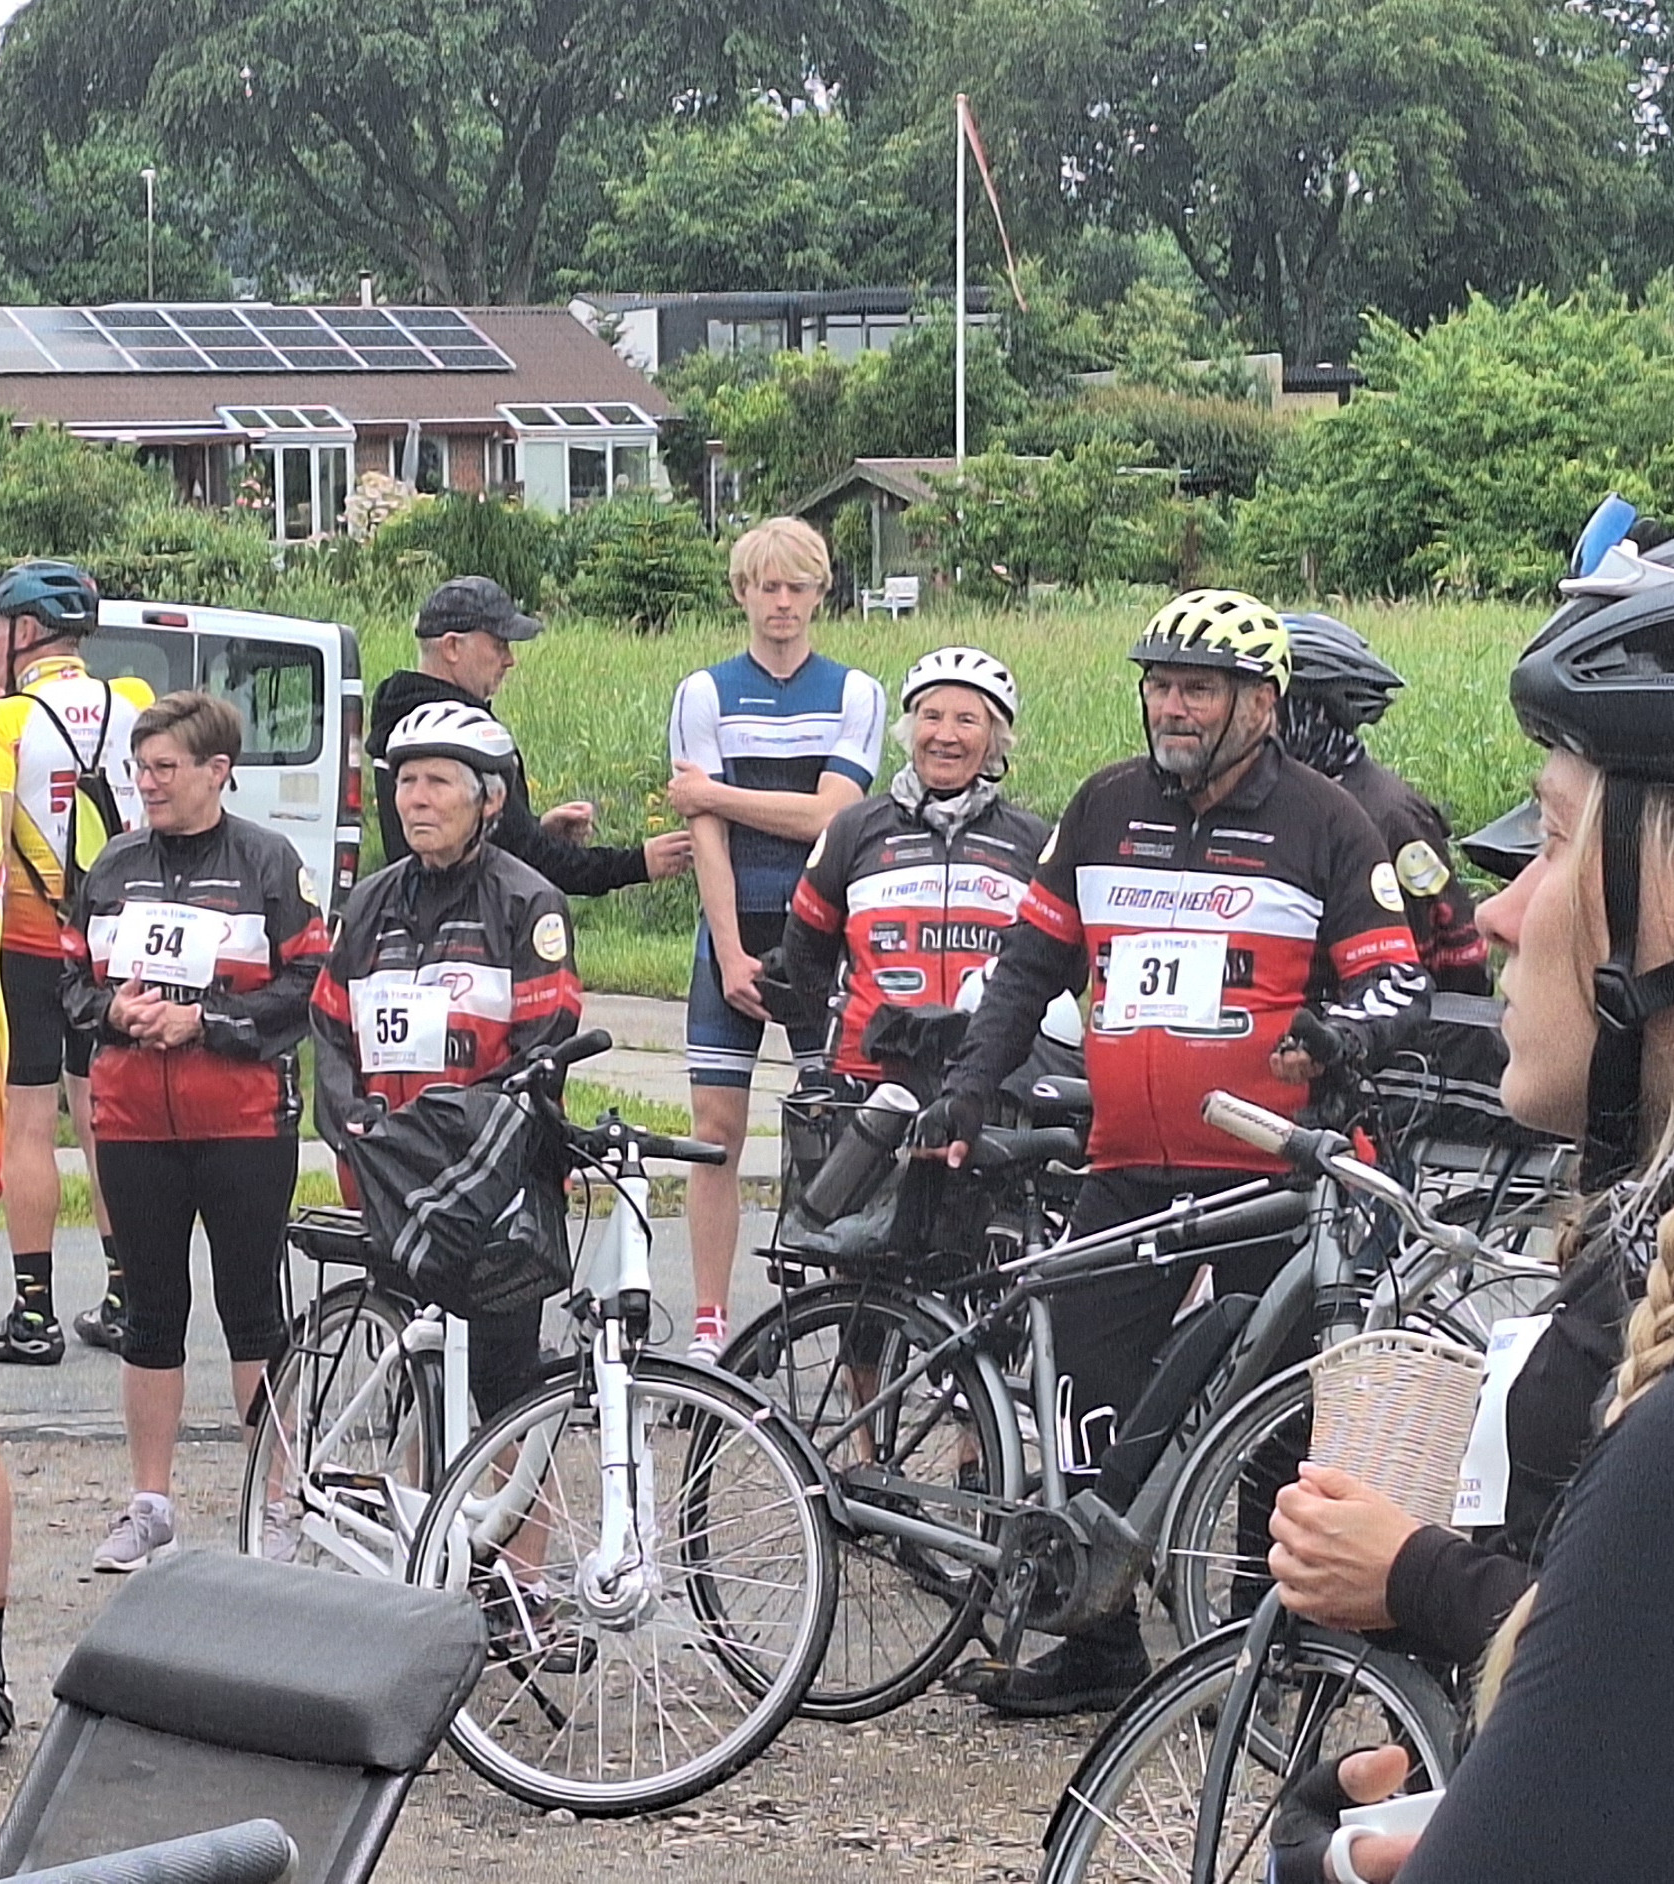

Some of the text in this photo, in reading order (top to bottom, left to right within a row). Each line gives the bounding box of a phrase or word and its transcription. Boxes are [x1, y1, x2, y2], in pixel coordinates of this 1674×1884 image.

[65, 705, 102, 723] OK
[1107, 886, 1152, 908] TEAM
[145, 924, 184, 958] 54
[1139, 957, 1180, 996] 31
[376, 1008, 408, 1044] 55
